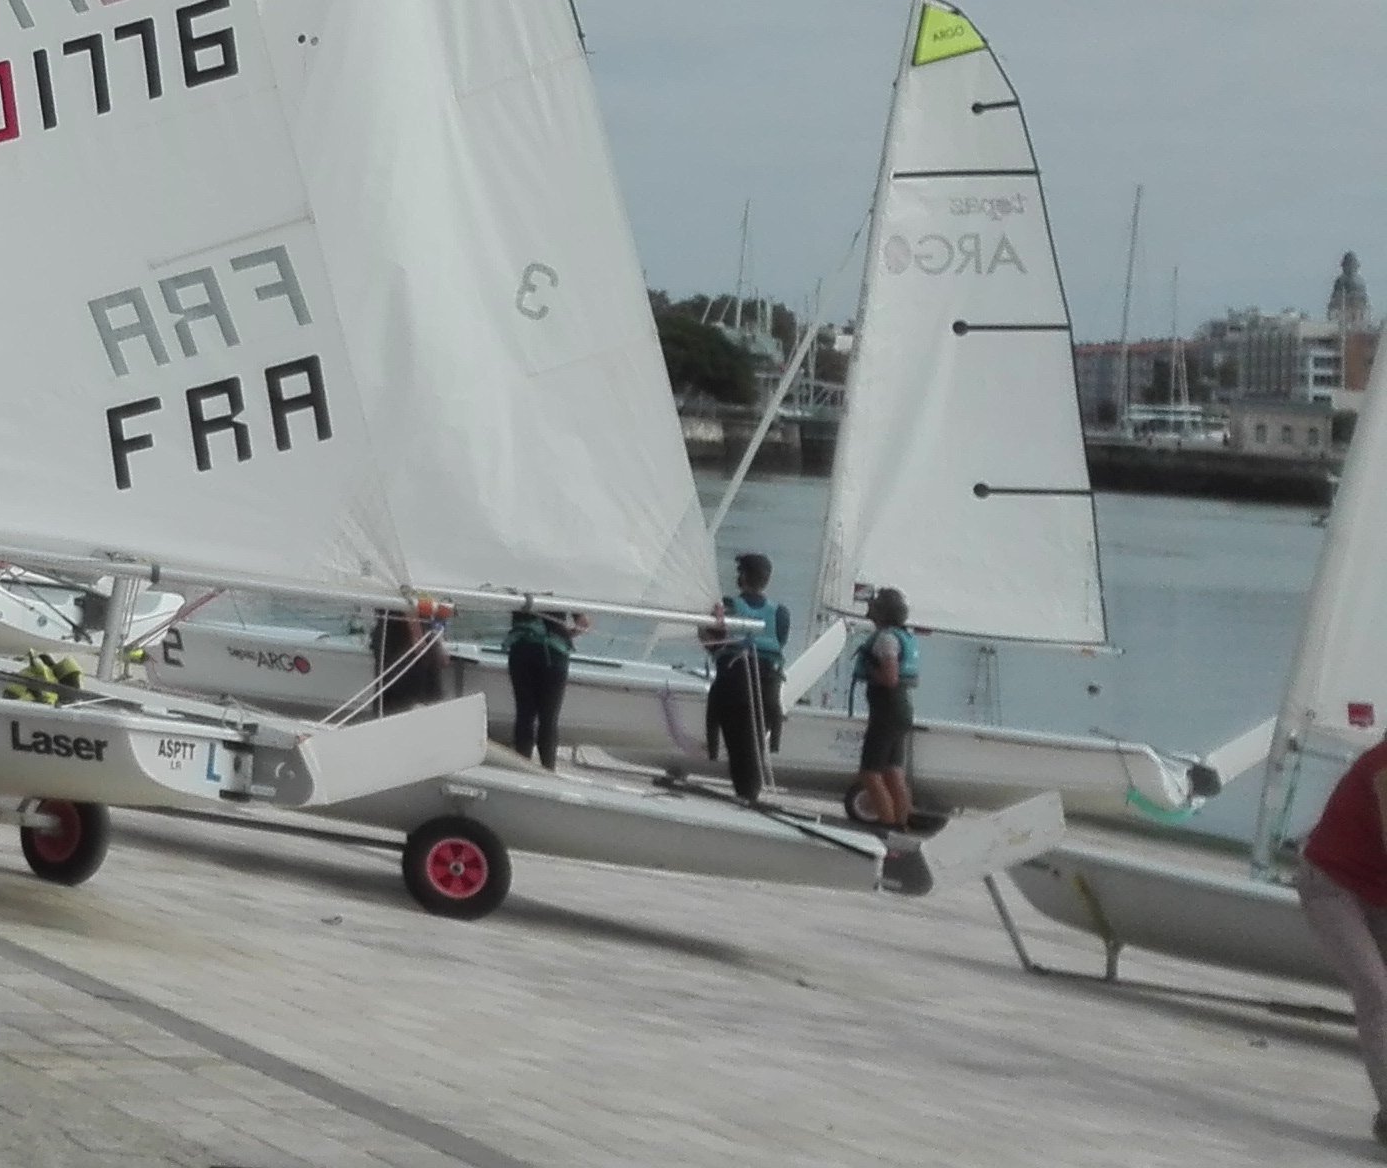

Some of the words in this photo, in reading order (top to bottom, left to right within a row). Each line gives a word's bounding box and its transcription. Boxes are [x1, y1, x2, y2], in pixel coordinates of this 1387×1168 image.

[106, 354, 333, 490] FRA
[256, 651, 311, 674] ARGO
[10, 721, 109, 762] Laser
[158, 738, 196, 760] ASPTT
